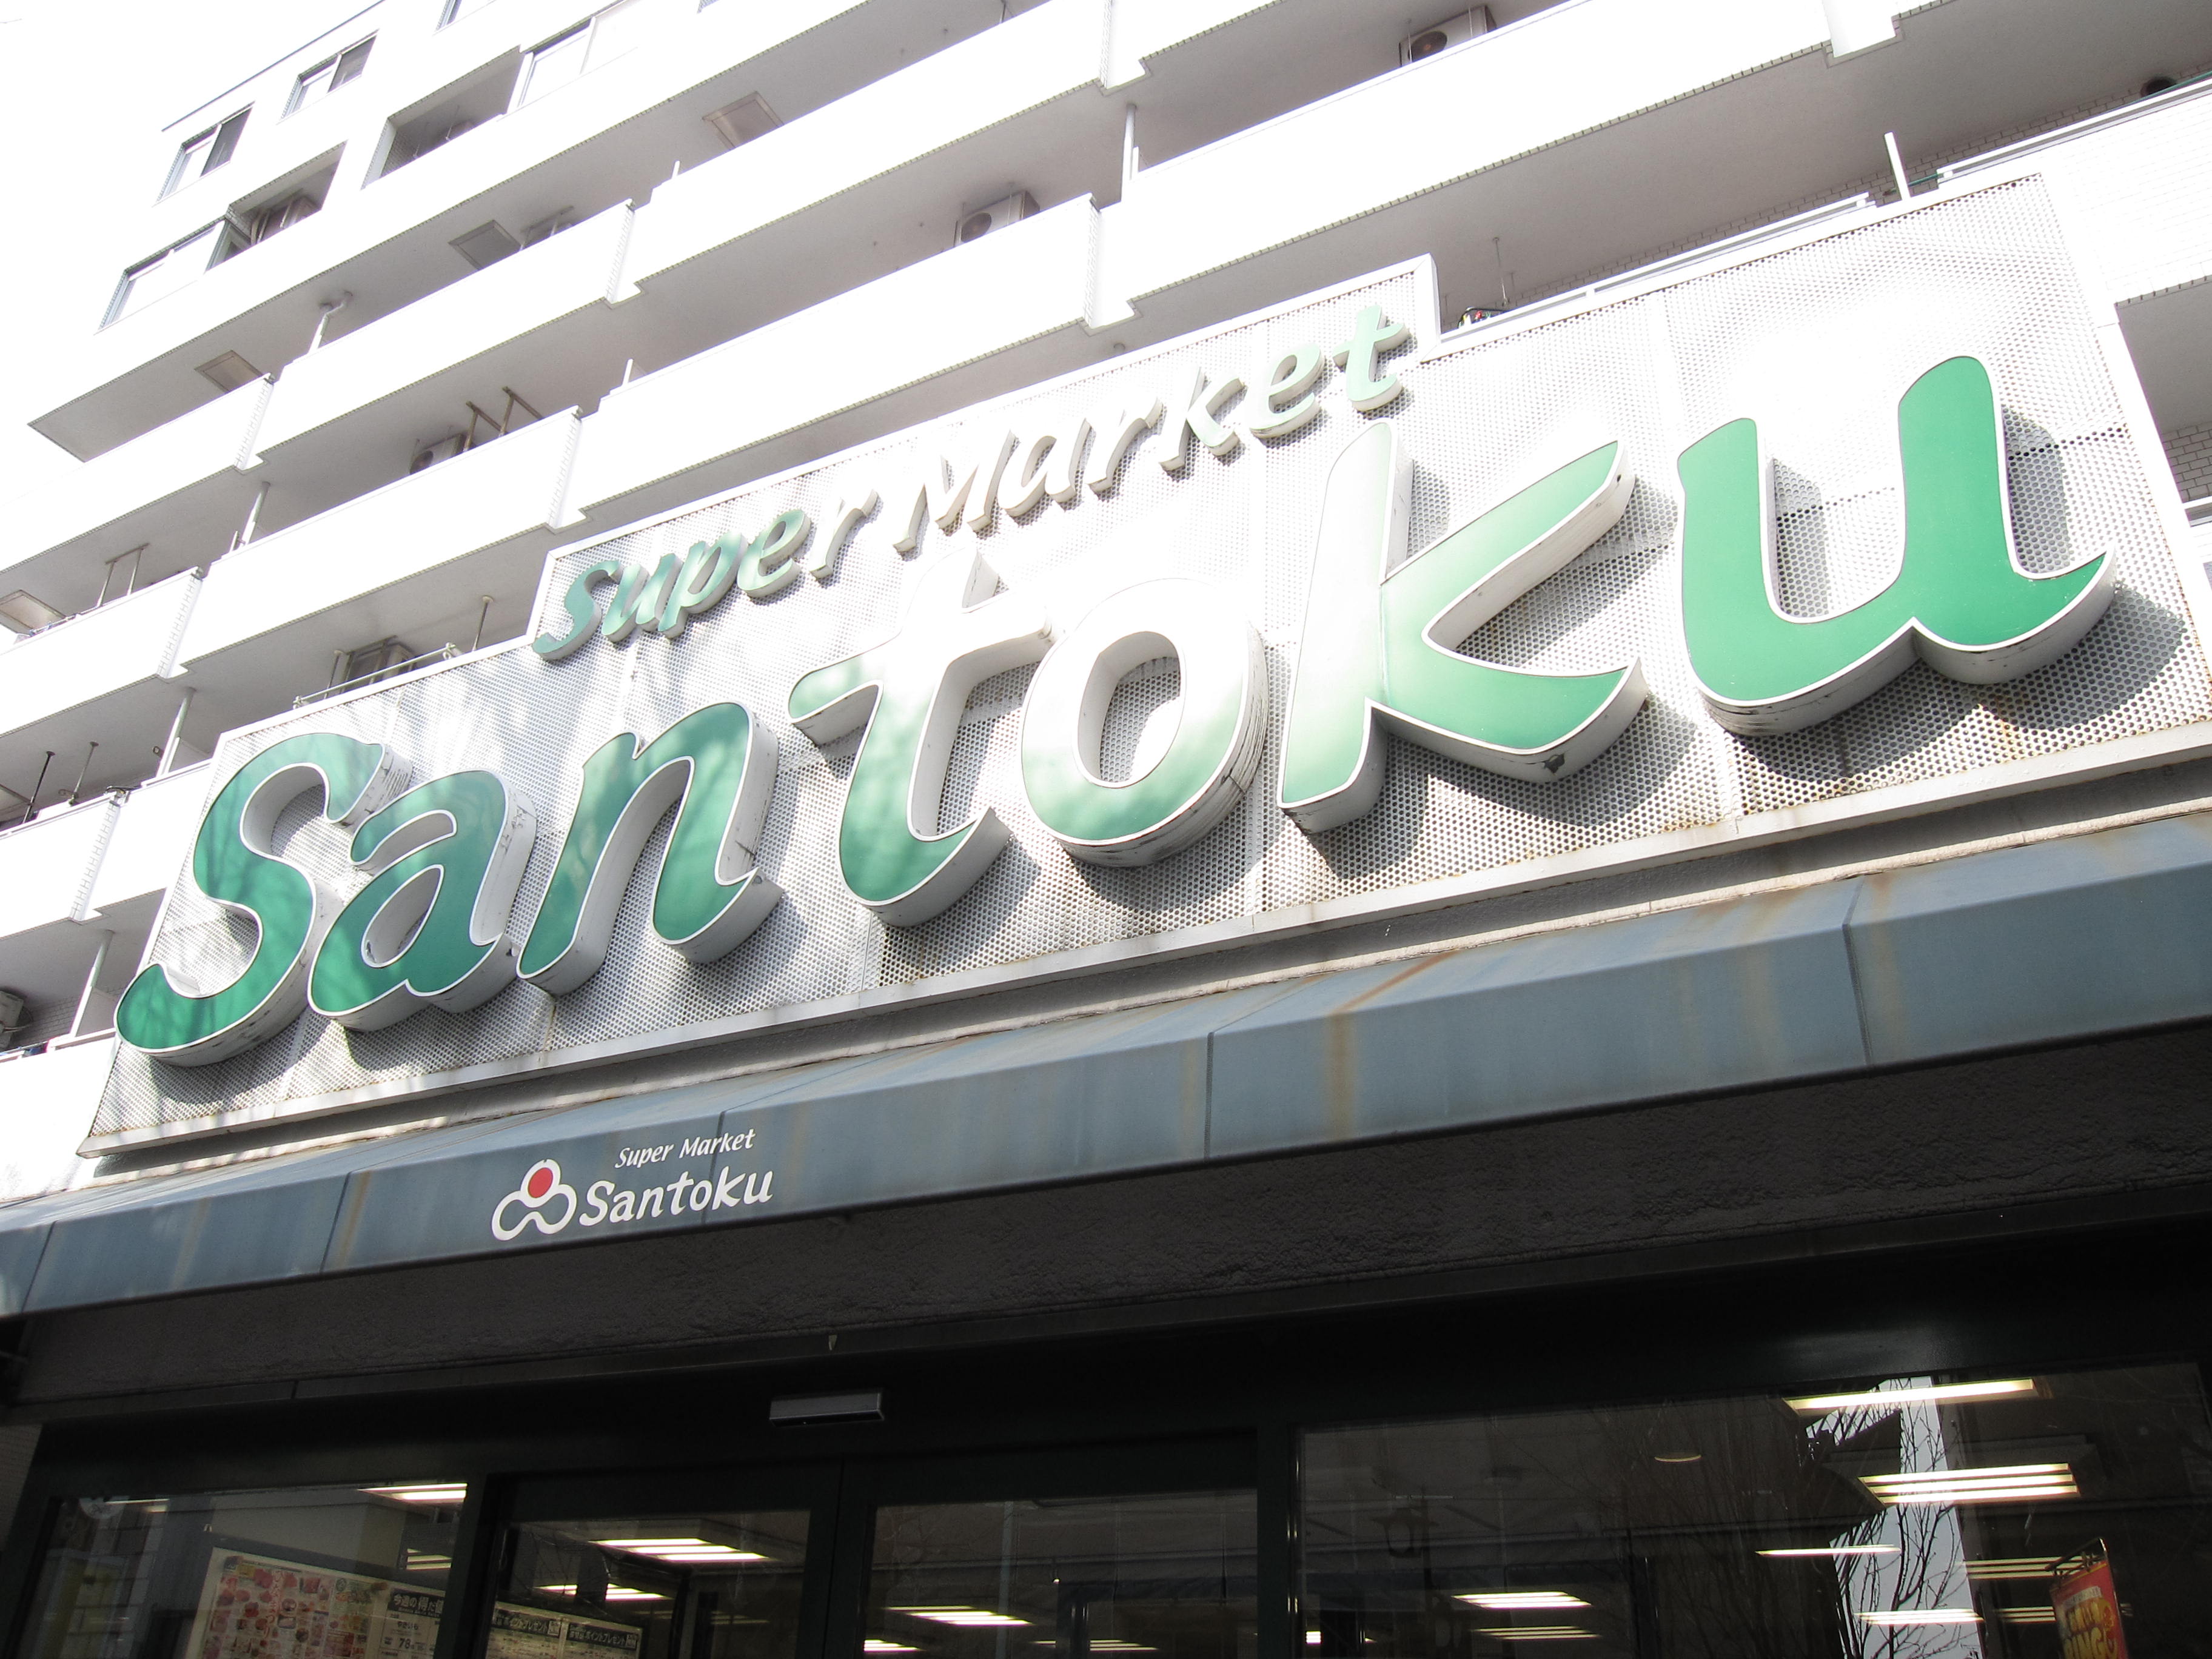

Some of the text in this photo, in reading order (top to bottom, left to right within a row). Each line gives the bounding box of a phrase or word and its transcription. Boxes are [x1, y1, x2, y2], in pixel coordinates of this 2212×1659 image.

[532, 303, 1410, 662] Super Market
[115, 355, 2116, 1065] Santoku
[578, 1165, 774, 1227] Santoku
[614, 1128, 756, 1169] Super Market
